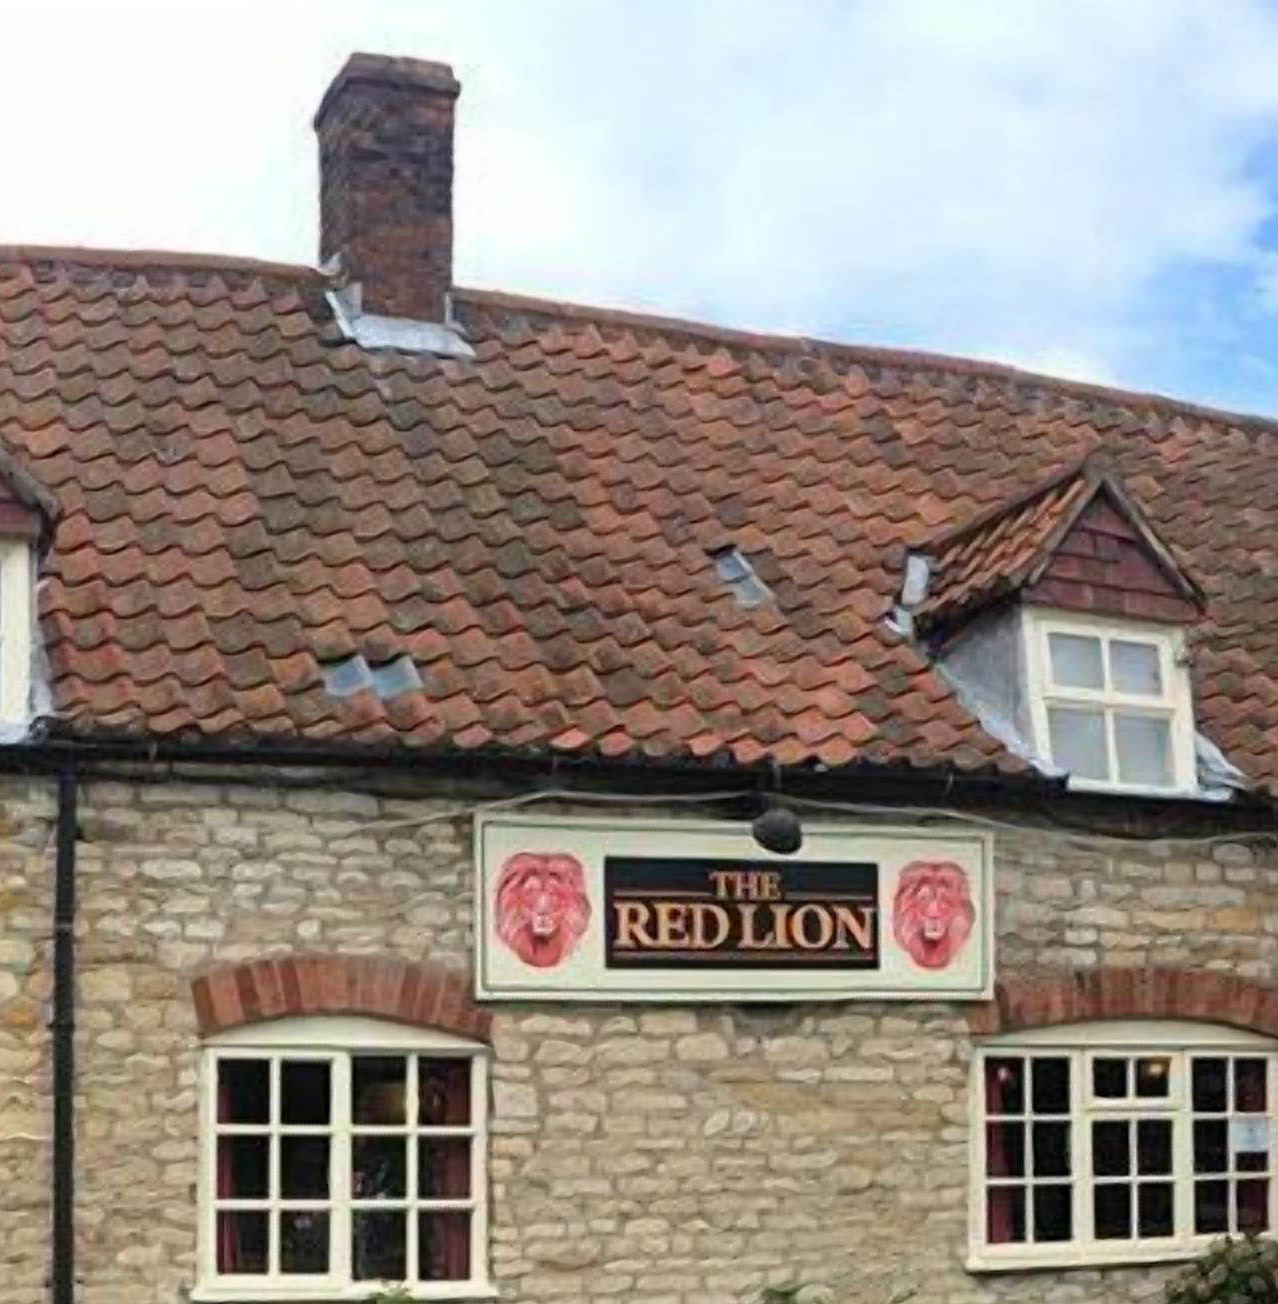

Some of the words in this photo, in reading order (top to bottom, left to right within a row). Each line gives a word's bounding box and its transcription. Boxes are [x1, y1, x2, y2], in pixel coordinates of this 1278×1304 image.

[710, 870, 782, 898] THE
[614, 903, 729, 948] RED
[736, 903, 876, 950] LION
